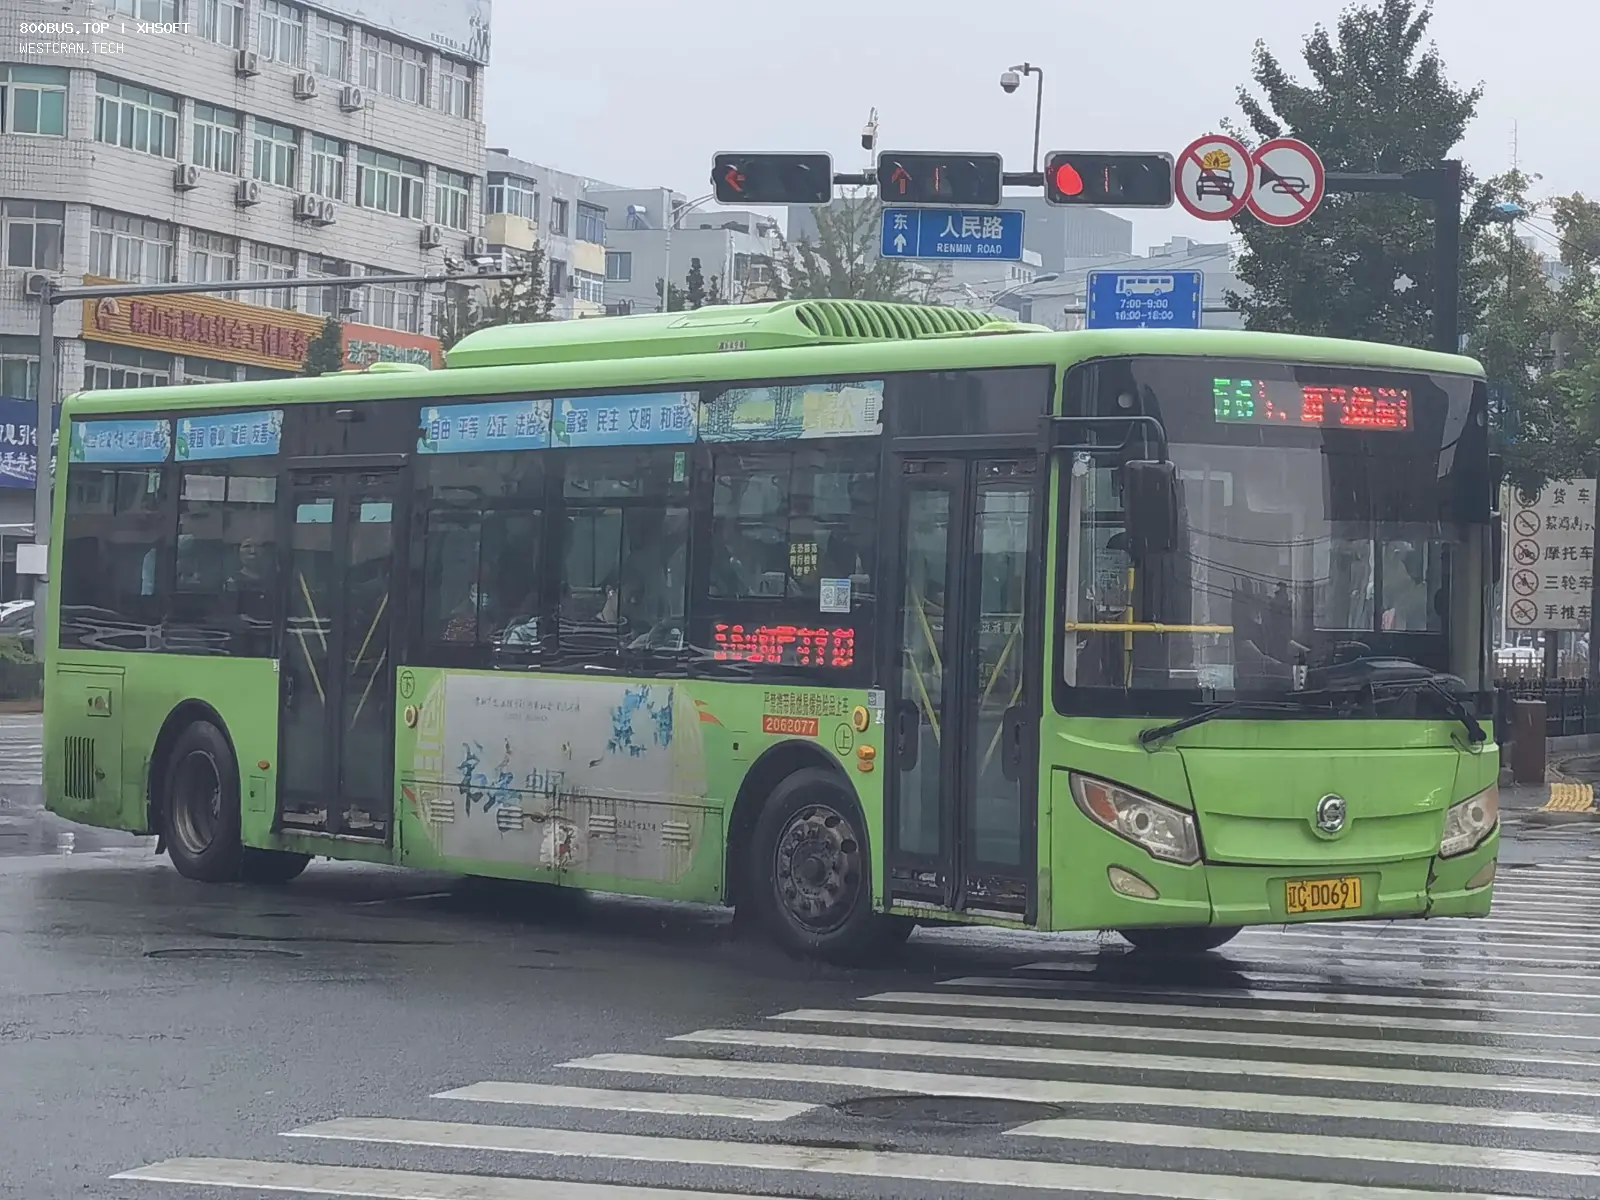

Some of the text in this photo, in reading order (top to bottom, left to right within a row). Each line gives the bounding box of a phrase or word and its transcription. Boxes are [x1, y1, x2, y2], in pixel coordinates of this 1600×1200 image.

[893, 213, 908, 230] 东
[940, 215, 1003, 239] 人民路
[936, 243, 1002, 254] RENMIN ROAD
[431, 413, 538, 441] 自由 平等 公正 法治
[565, 410, 588, 434] 富强
[596, 408, 619, 433] 民主
[628, 407, 651, 432] 文明
[1544, 546, 1593, 561] 摩托车
[1544, 575, 1593, 590] 三轮车
[1544, 604, 1591, 620] 手推车
[766, 717, 815, 734] 2062077
